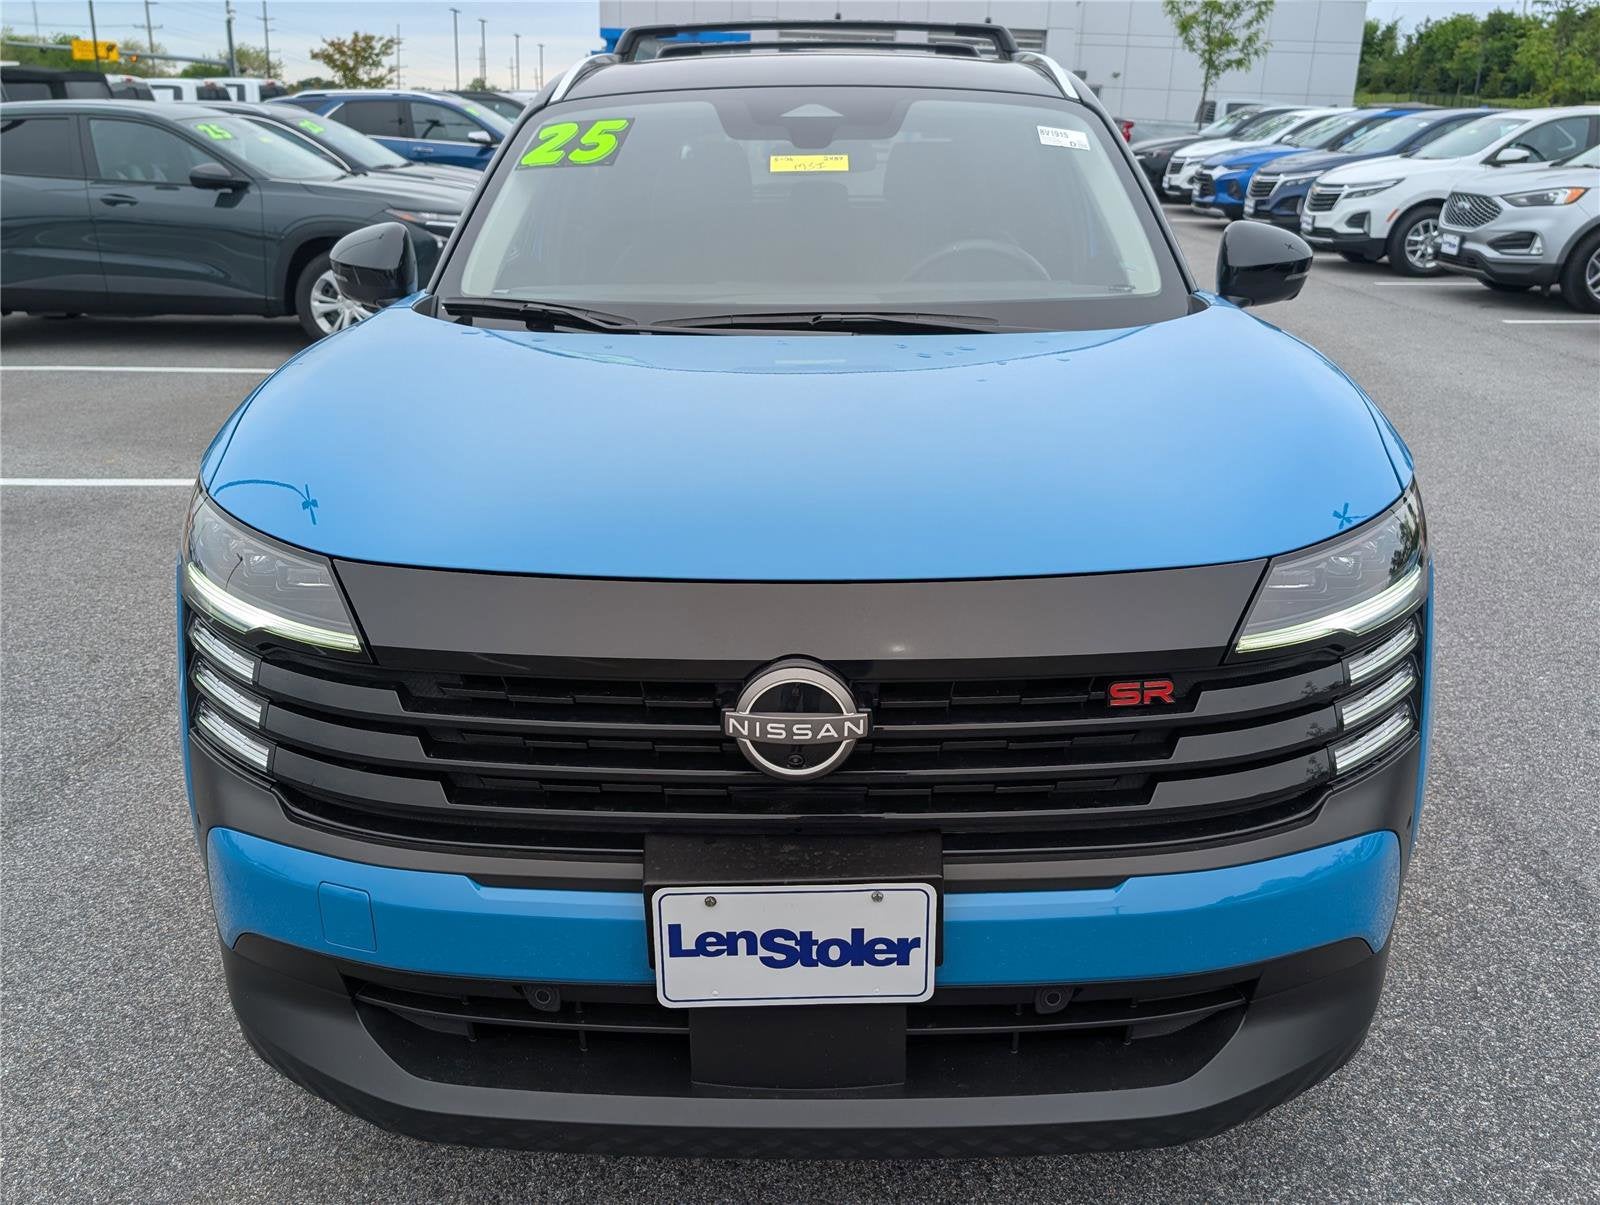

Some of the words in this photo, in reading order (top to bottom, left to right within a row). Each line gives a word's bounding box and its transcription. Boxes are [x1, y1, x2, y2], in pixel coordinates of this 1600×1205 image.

[521, 119, 629, 166] 25
[1109, 680, 1175, 706] SR
[728, 717, 864, 740] NISSAN
